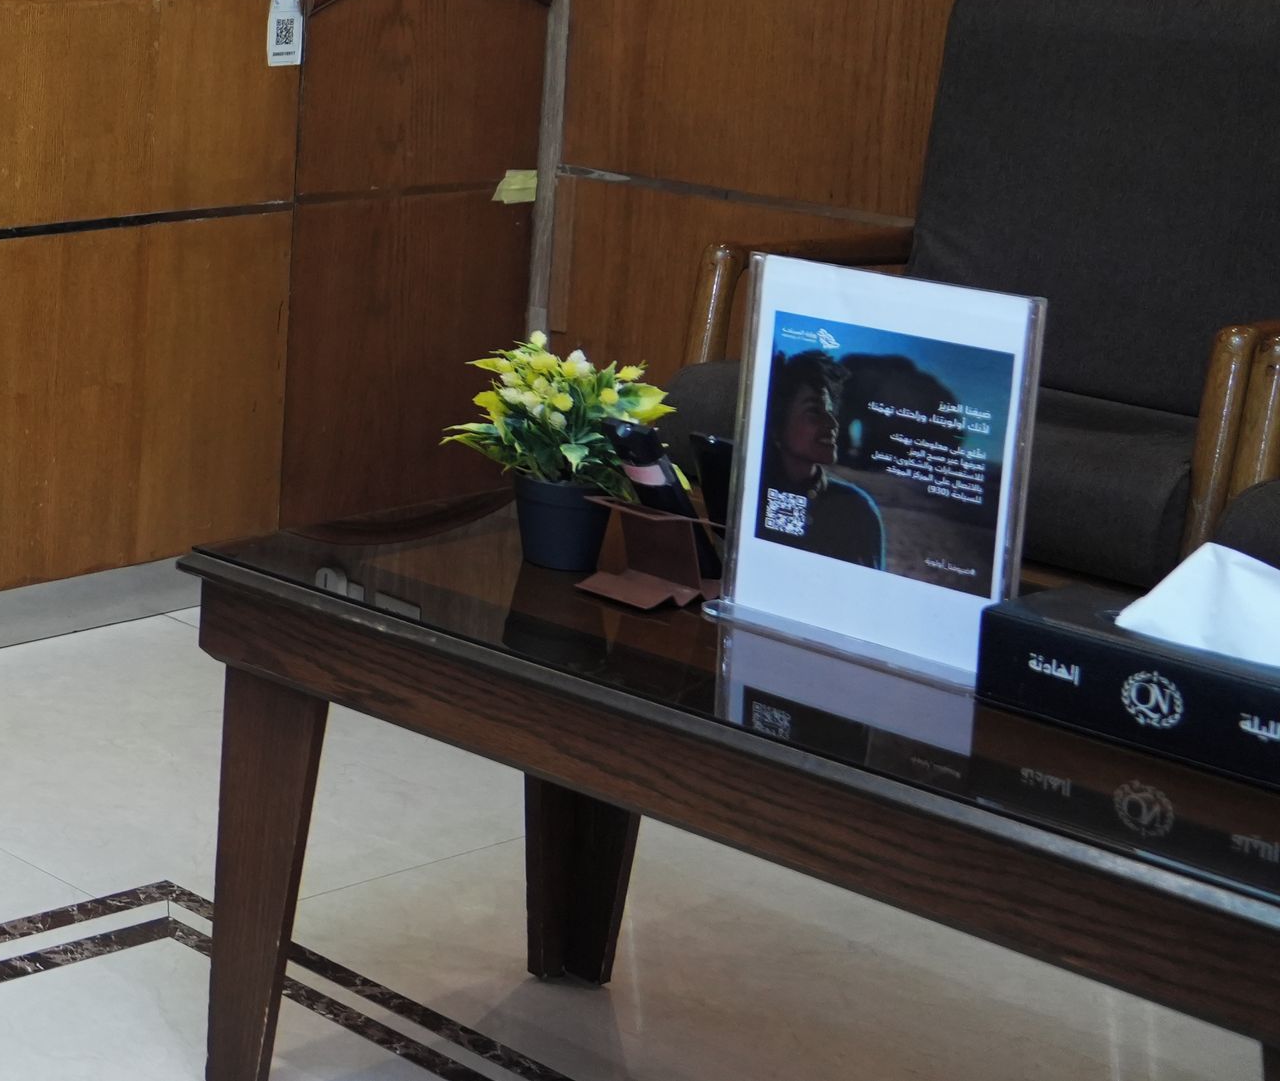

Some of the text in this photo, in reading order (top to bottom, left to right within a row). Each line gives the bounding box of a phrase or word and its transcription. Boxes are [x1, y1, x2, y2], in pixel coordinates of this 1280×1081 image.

[896, 408, 928, 423] وراحتك
[938, 402, 991, 419] ضيفنا العزيز
[967, 422, 989, 434] لأنك
[914, 439, 948, 452] معلومات
[949, 446, 965, 455] على
[912, 471, 933, 481] المركز
[934, 477, 951, 485] على
[927, 485, 982, 504] للسياحة (930)
[1028, 652, 1080, 686] الهادئة
